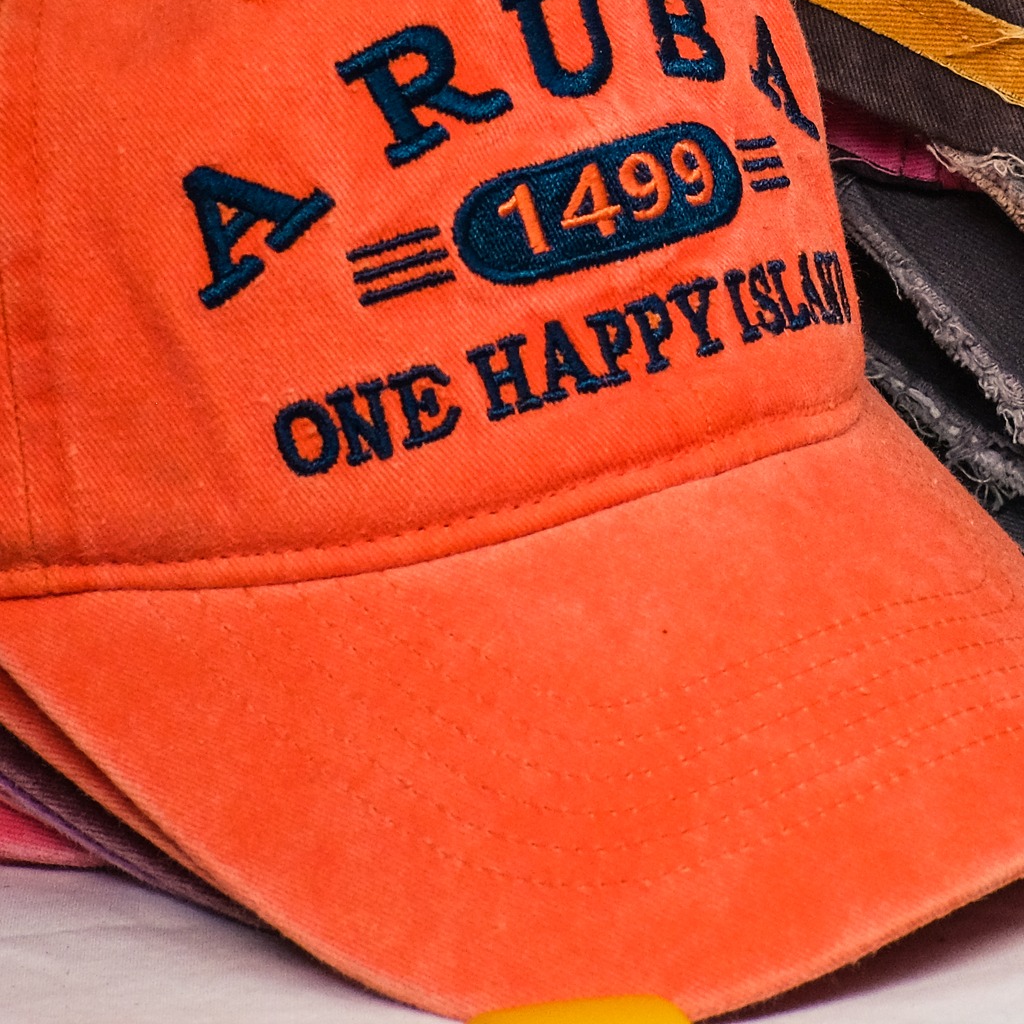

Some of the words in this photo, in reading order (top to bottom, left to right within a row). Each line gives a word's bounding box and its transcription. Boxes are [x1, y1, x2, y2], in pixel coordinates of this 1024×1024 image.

[497, 139, 716, 254] 1499
[273, 364, 461, 476] ONE
[466, 276, 724, 421] HAPPY
